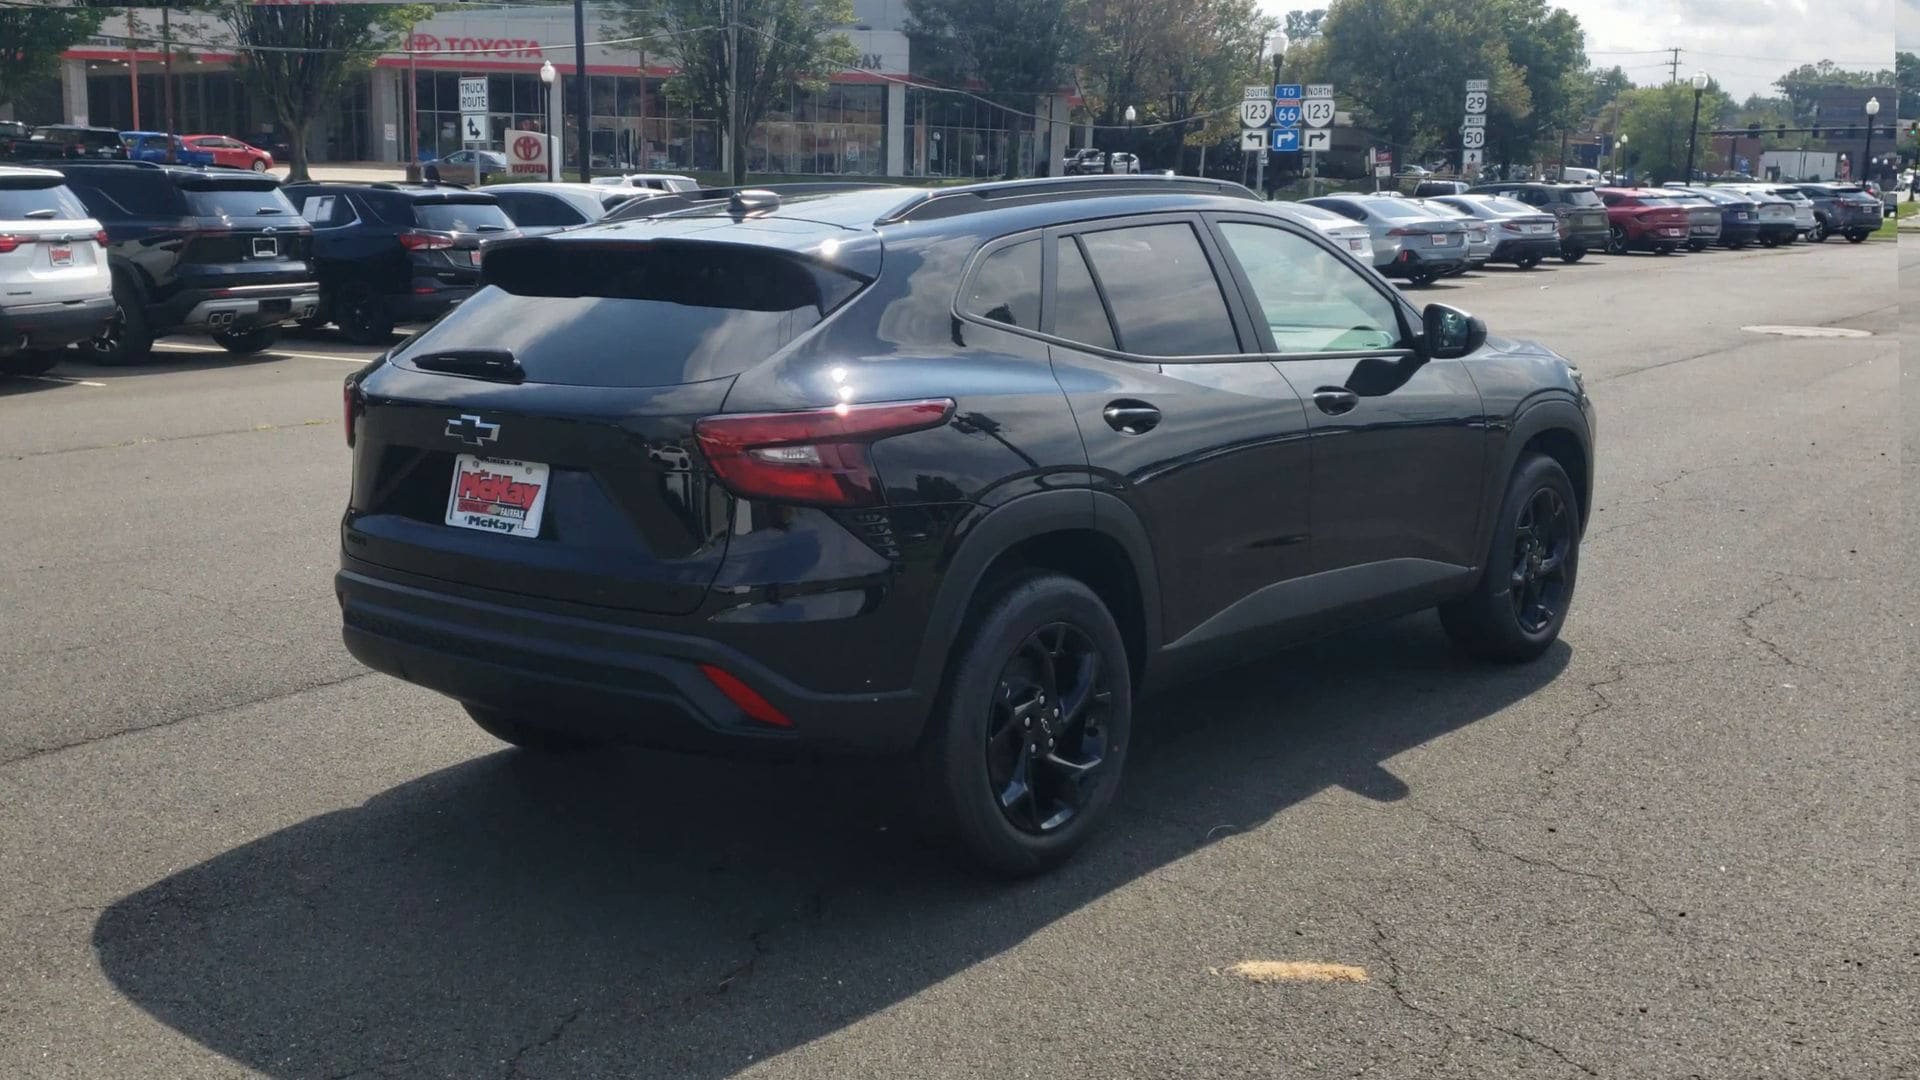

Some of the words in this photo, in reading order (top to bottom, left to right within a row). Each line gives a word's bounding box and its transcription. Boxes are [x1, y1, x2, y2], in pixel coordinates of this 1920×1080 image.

[445, 37, 543, 58] TOYOTA
[461, 83, 485, 93] TRUCK
[1246, 88, 1268, 97] SOUTH
[1282, 88, 1295, 96] TO
[1308, 87, 1332, 96] NORTH
[462, 97, 486, 107] ROUTE
[1468, 97, 1485, 109] 29
[1245, 104, 1267, 120] 123
[1279, 108, 1296, 121] 66
[1308, 104, 1330, 119] 123
[1466, 132, 1482, 144] 50
[458, 470, 541, 512] McKay
[467, 515, 516, 533] McKay
